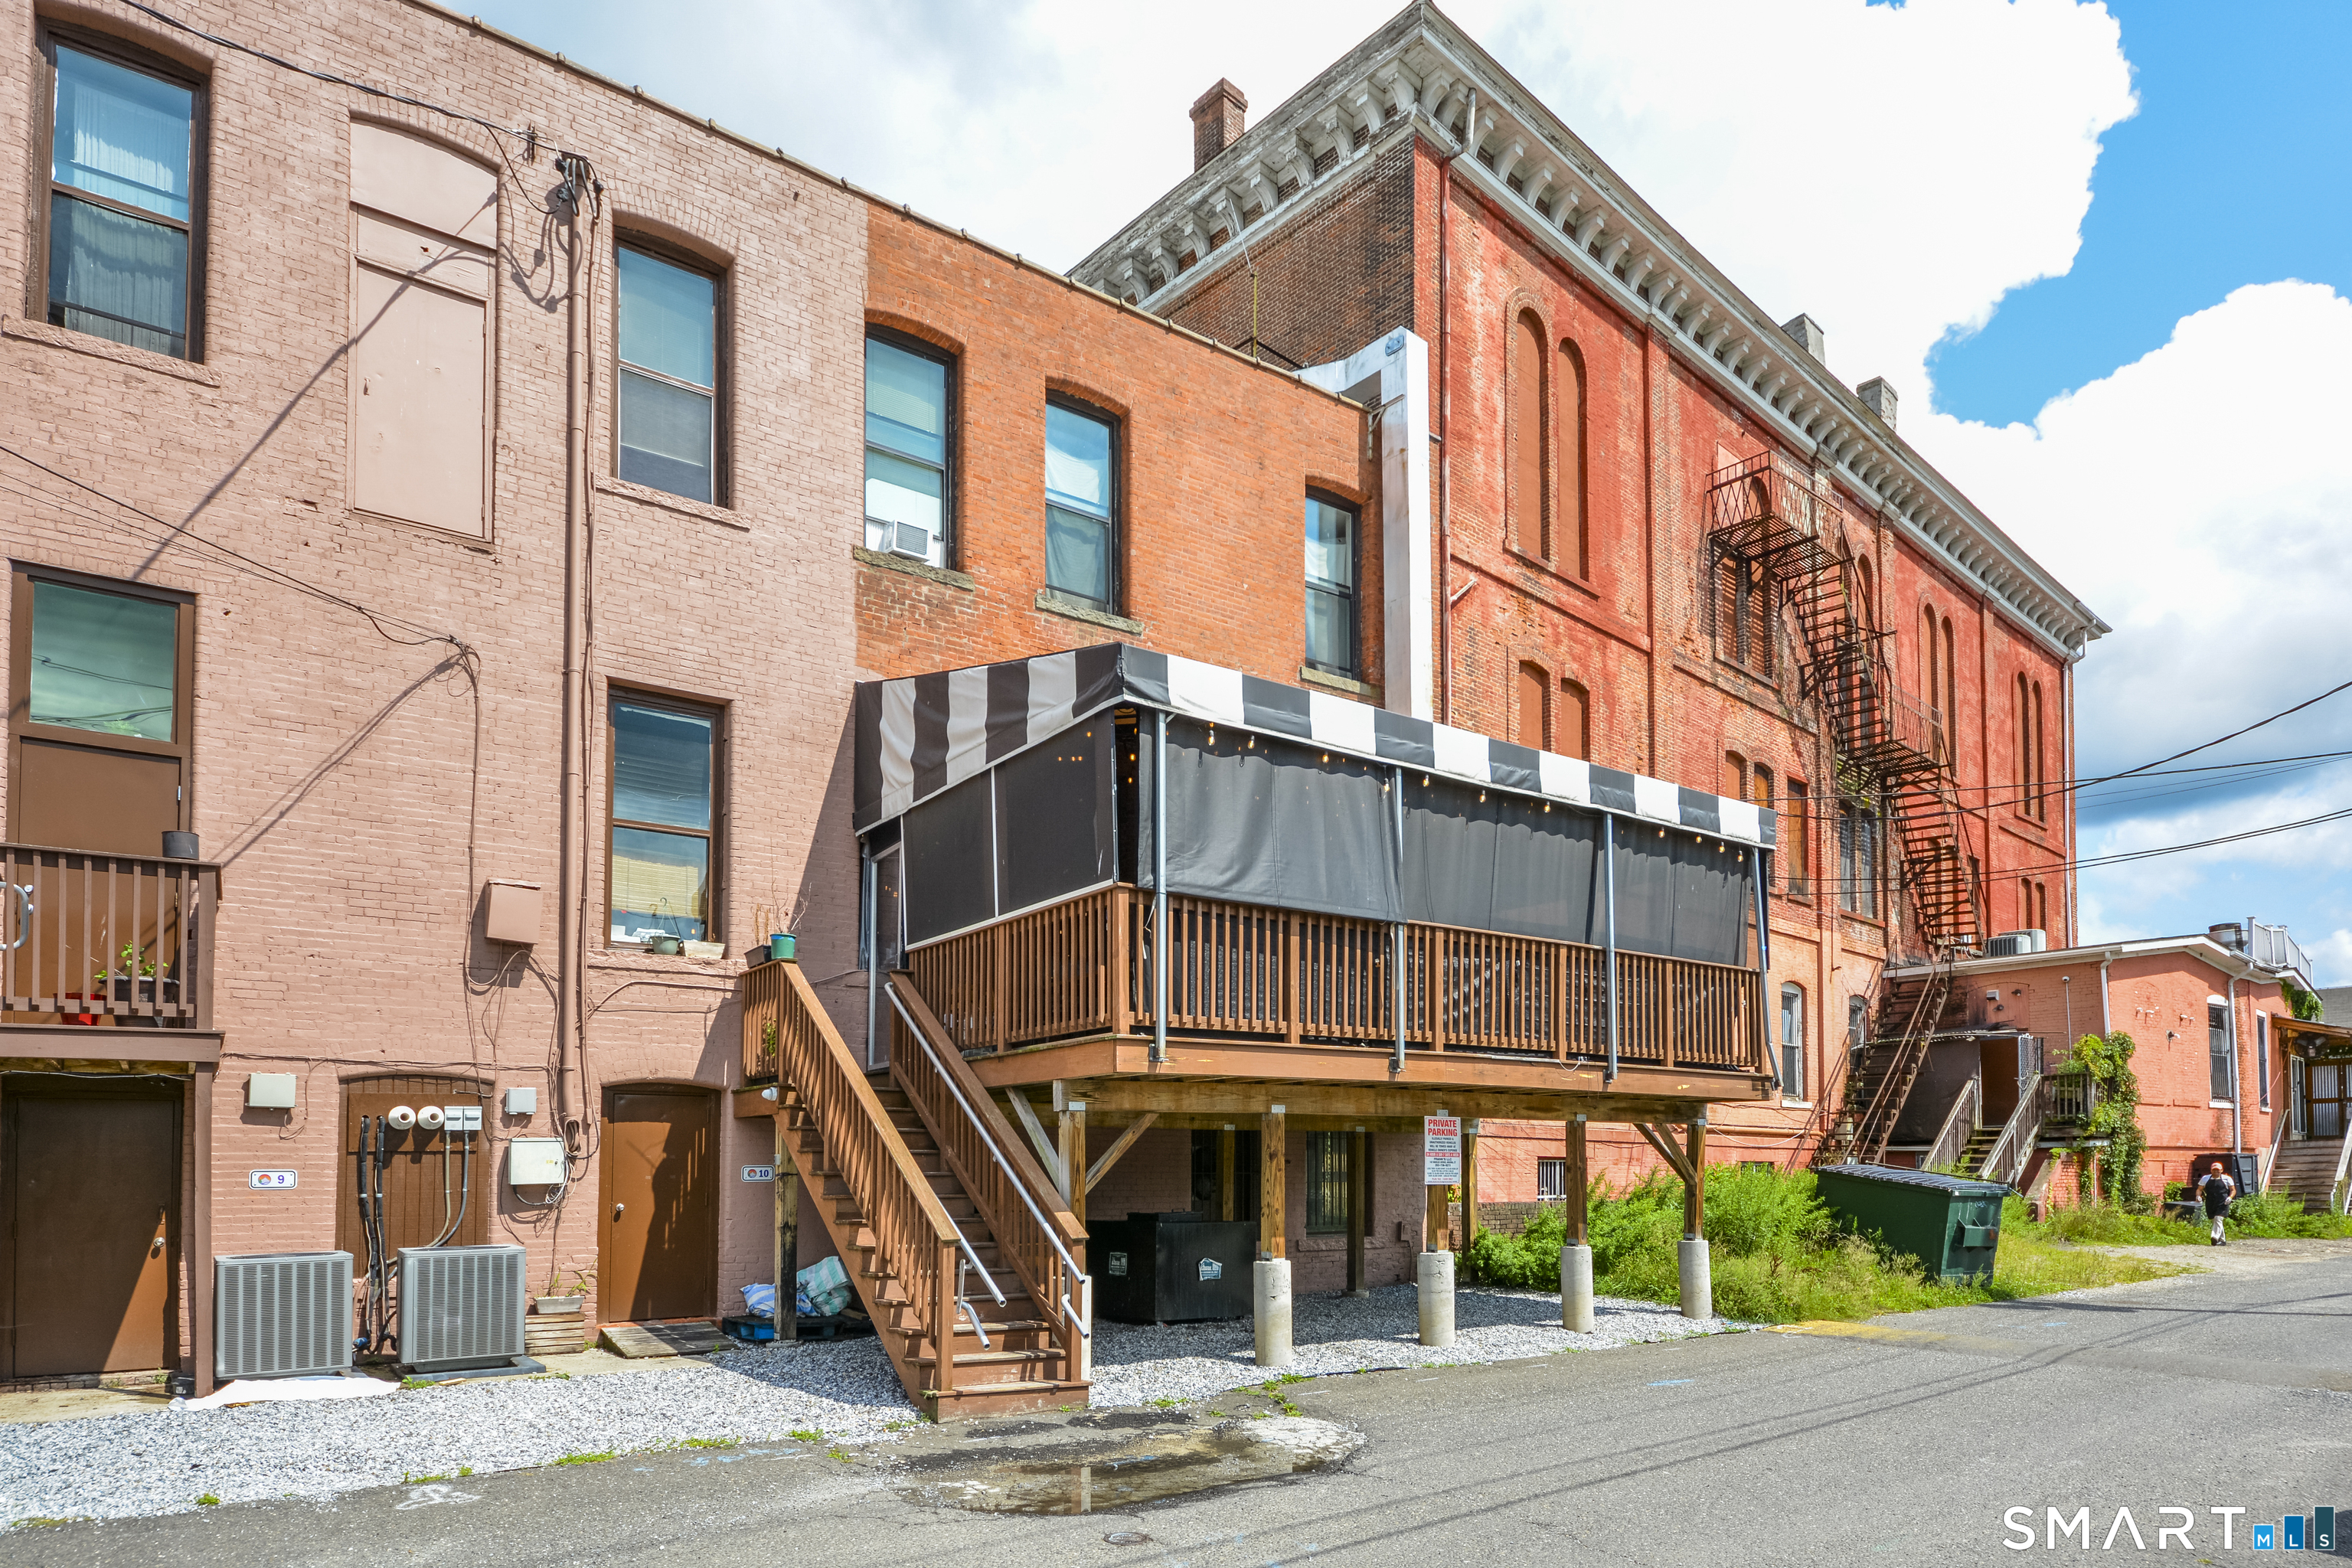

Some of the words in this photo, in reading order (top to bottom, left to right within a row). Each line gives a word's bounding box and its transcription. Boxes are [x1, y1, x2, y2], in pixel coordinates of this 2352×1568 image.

[1428, 1119, 1457, 1128] PRIVATE
[1428, 1128, 1458, 1136] PARKING
[759, 1169, 769, 1178] 10
[277, 1174, 284, 1184] 9
